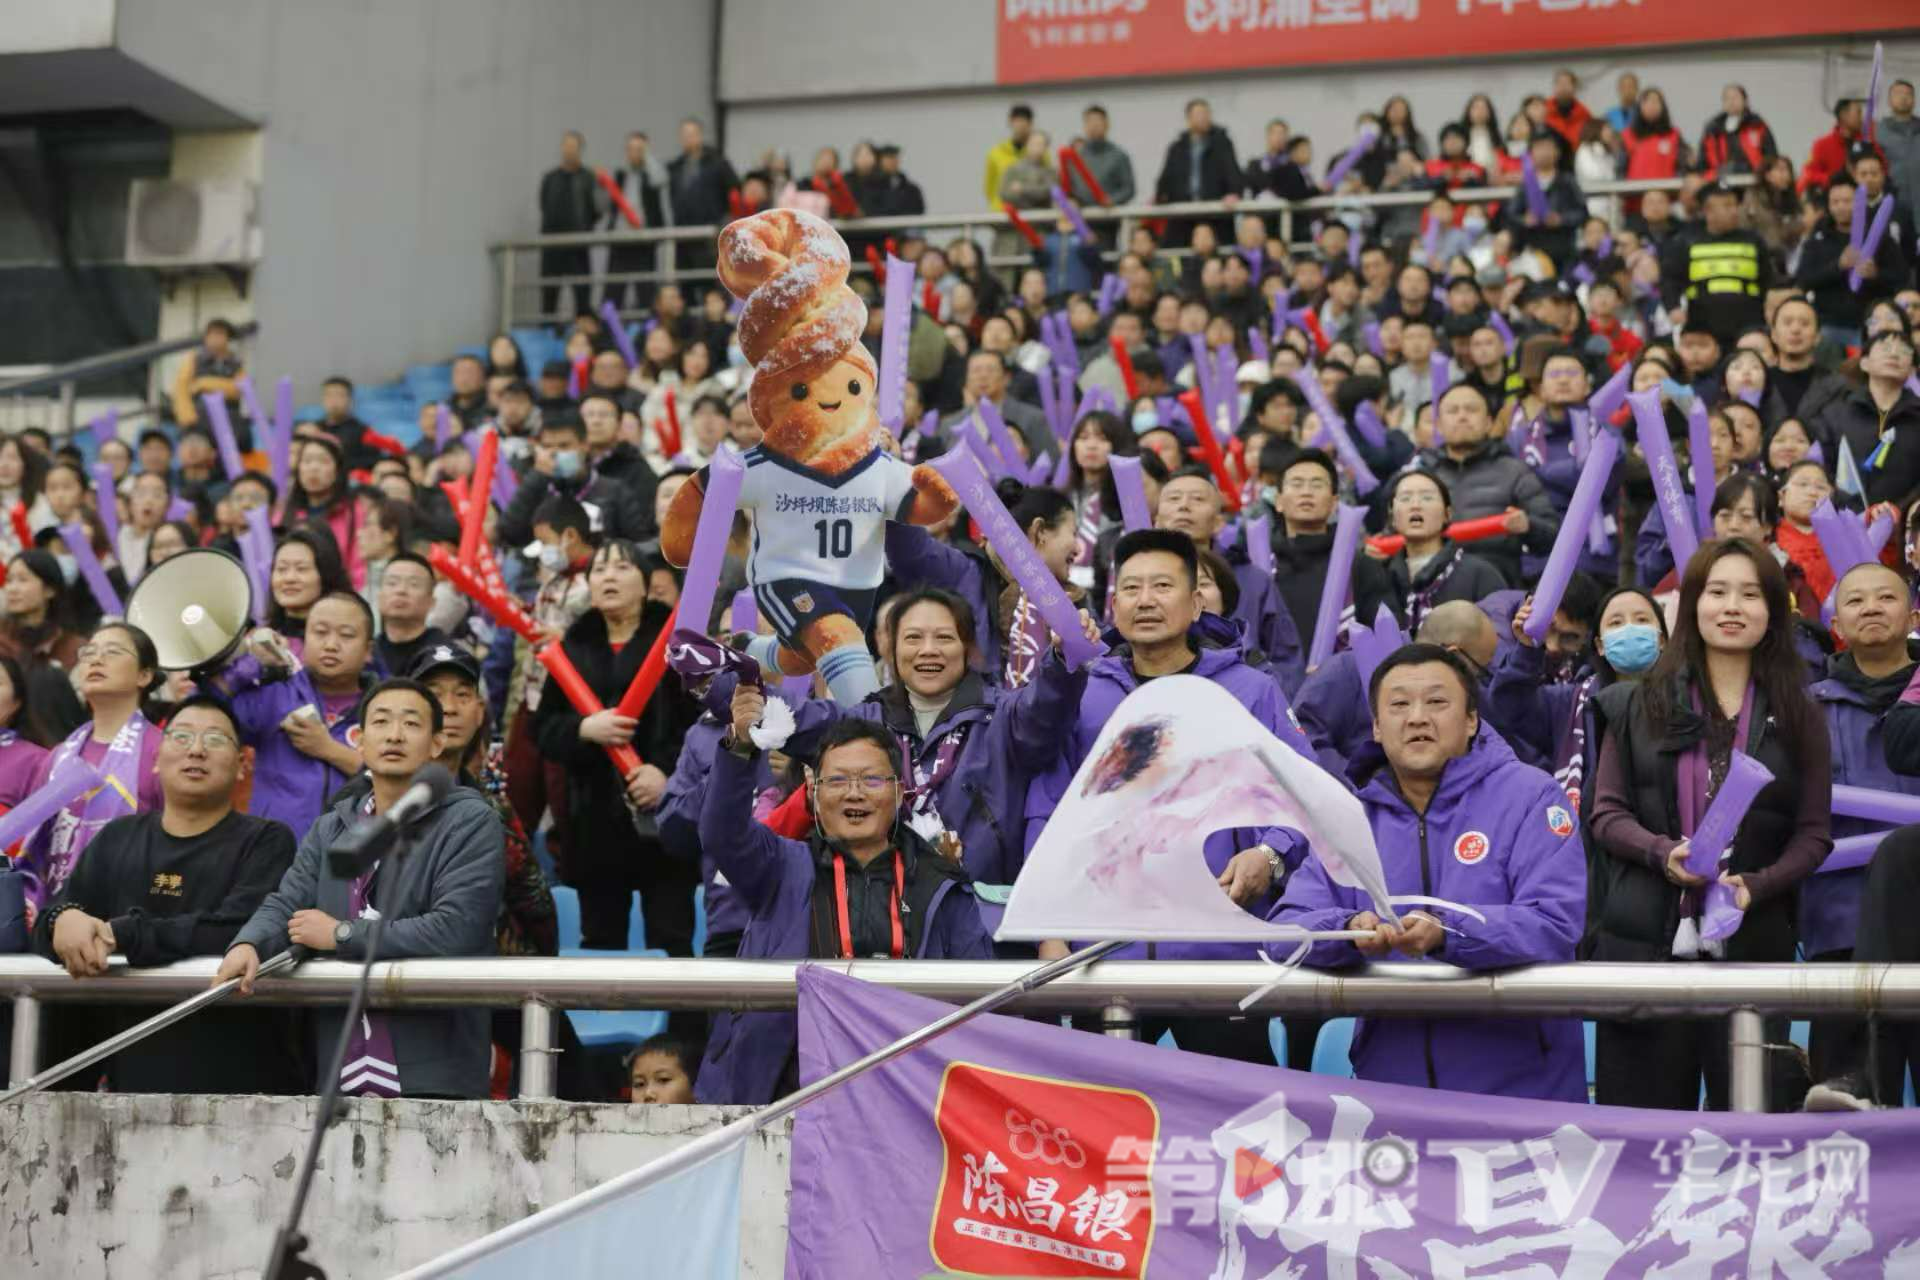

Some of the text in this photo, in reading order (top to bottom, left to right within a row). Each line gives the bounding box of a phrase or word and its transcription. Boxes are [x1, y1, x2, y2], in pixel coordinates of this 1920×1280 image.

[775, 492, 882, 514] 沙坪坝陈昌银队
[814, 518, 853, 559] 10
[962, 1150, 1133, 1242] 陈昌银
[1210, 1094, 1920, 1280] 陈昌银
